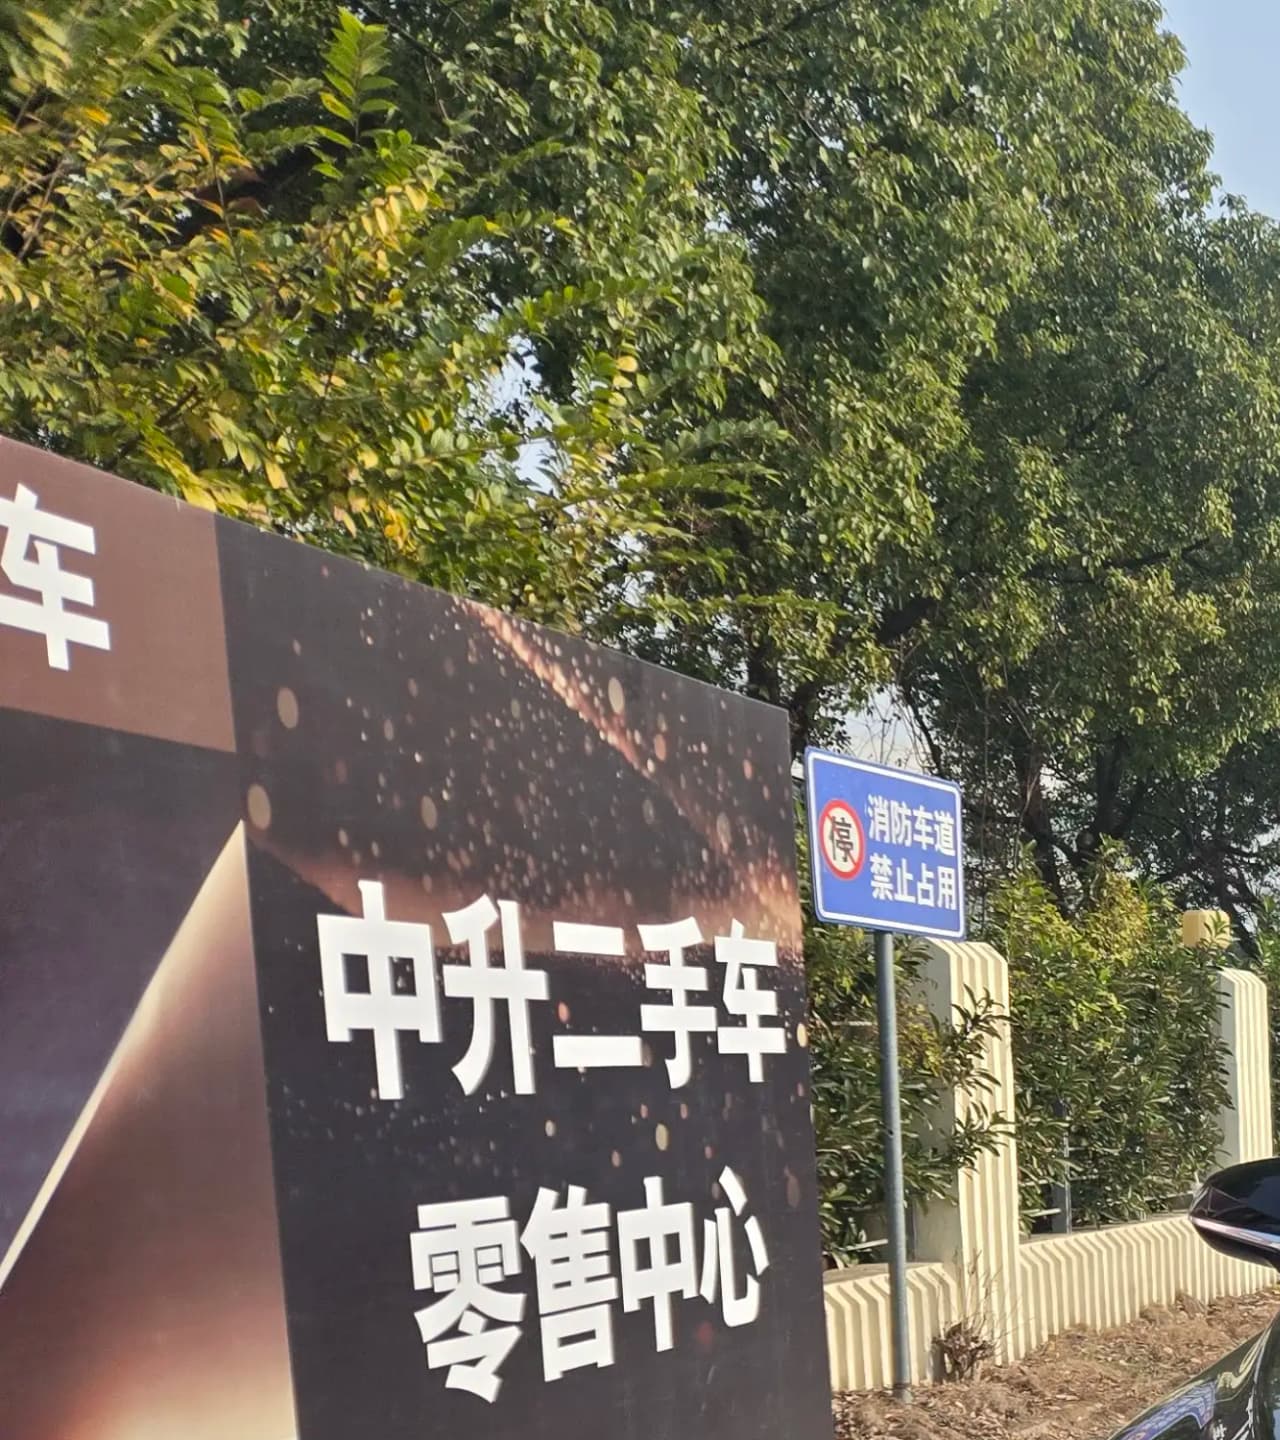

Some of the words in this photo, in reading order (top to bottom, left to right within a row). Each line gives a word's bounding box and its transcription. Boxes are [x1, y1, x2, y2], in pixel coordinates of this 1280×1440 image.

[829, 815, 854, 863] 停
[865, 795, 956, 856] 消防车道
[870, 853, 957, 910] 禁止占用
[316, 880, 787, 1100] 中升二手车
[410, 1166, 770, 1403] 零售中心
